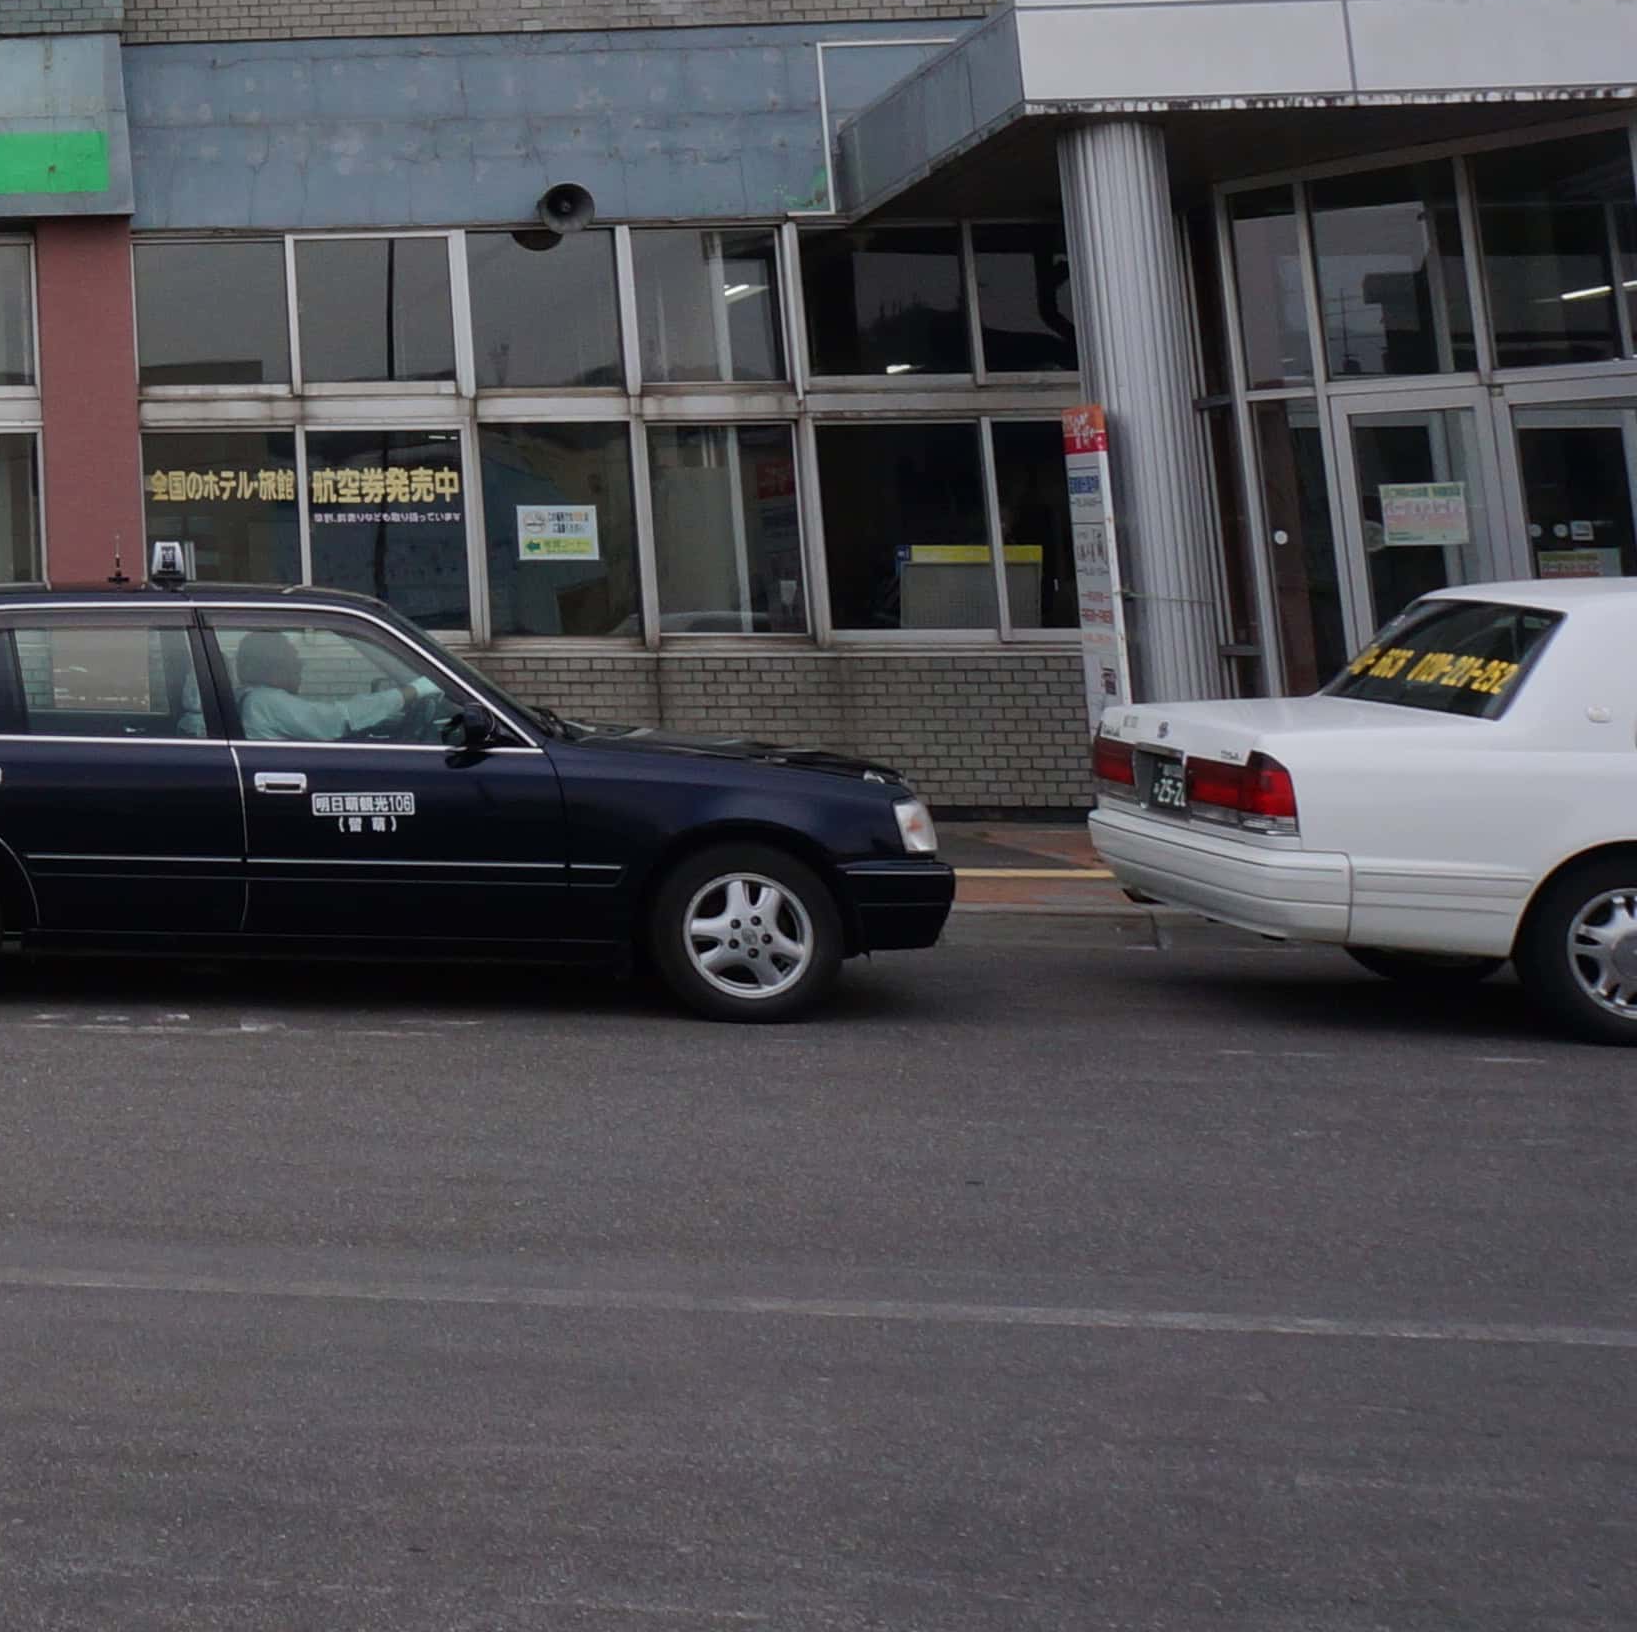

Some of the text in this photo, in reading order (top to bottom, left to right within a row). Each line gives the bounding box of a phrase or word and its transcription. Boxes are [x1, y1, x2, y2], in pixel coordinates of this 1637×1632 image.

[312, 466, 460, 504] 航空券発売中
